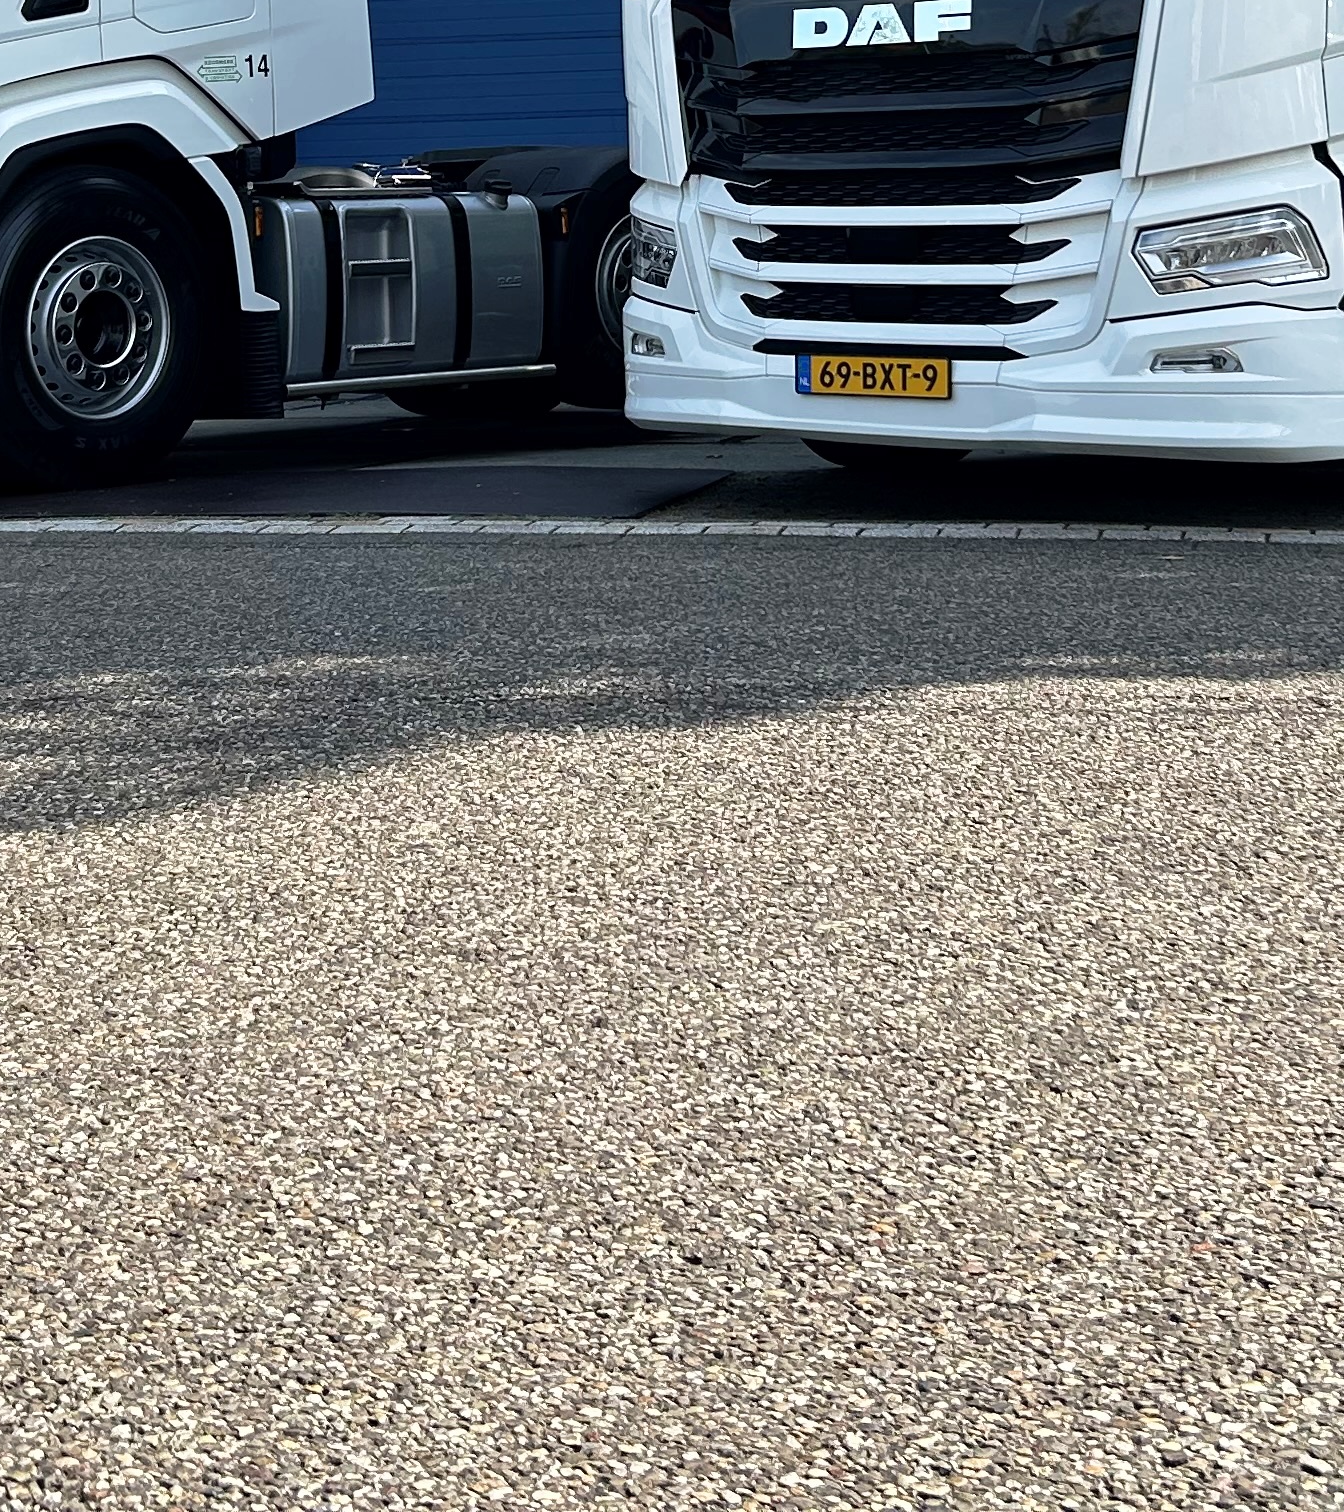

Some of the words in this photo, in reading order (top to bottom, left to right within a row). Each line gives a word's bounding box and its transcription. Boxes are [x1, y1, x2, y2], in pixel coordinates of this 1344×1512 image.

[244, 54, 270, 78] 14
[799, 377, 810, 387] NL
[819, 360, 938, 392] 69-BXT-9
